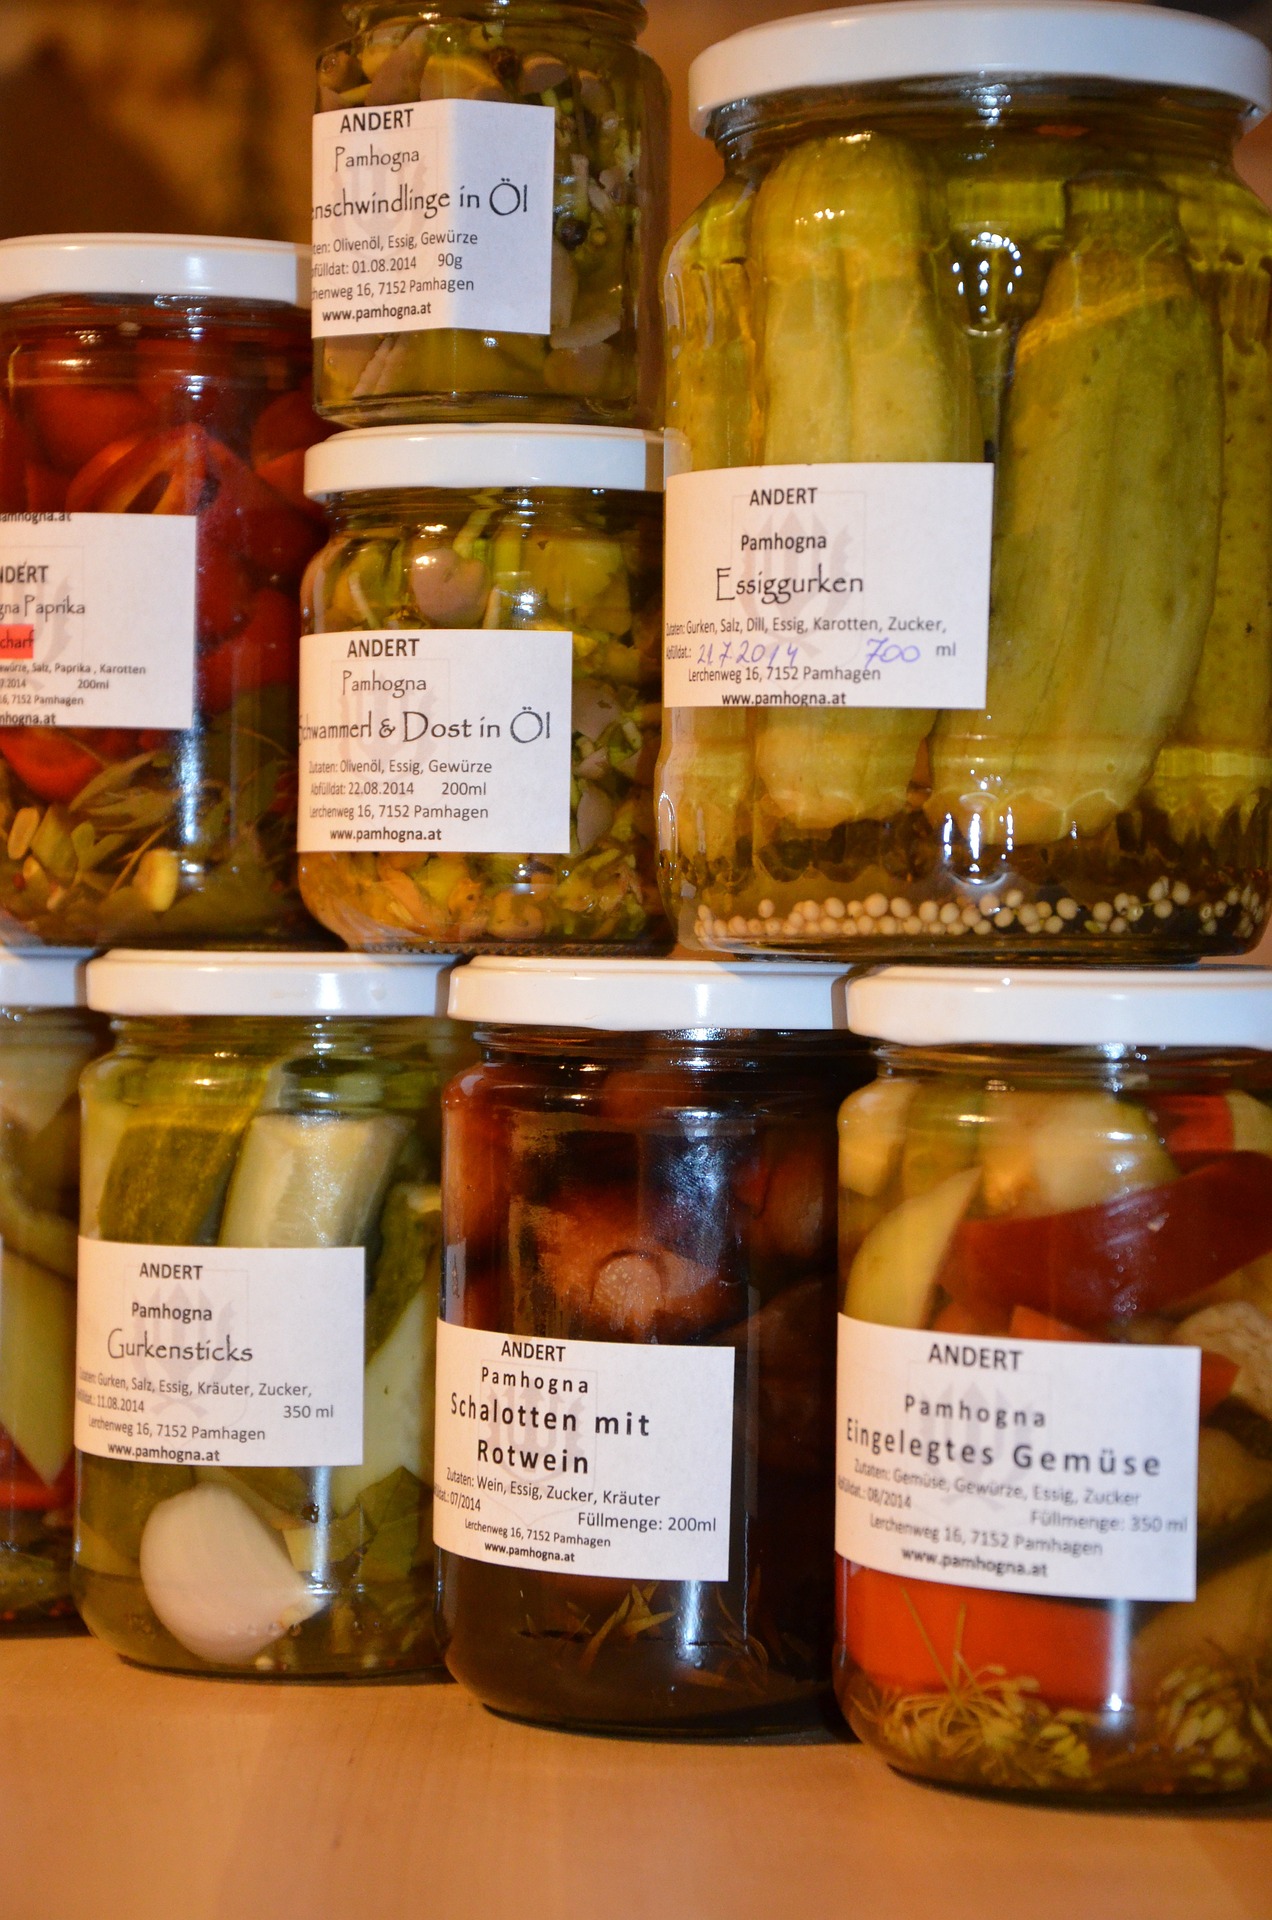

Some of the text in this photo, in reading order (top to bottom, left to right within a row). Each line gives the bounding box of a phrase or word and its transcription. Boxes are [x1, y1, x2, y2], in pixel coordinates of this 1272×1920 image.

[340, 109, 414, 133] ANDERT
[335, 144, 420, 172] Pamhogna
[460, 185, 480, 208] in
[489, 178, 527, 216] Öl
[333, 236, 383, 252] Olivenöl,
[388, 233, 417, 249] Essig,
[421, 230, 478, 246] Gewürze
[352, 256, 416, 274] 01.08.2014
[438, 253, 462, 269] 90g
[312, 277, 474, 301] henweg 16, 7152 Pamhagen
[323, 302, 431, 322] www.pamhogna.at
[750, 487, 818, 506] ANDERT
[741, 533, 827, 553] Pamhogna
[716, 563, 864, 603] Essiggurken
[24, 595, 86, 622] Paprika
[687, 618, 717, 634] Gurken,
[720, 618, 742, 633] Salz,
[746, 617, 768, 632] Dill,
[773, 617, 808, 634] Essig,
[813, 616, 882, 632] Karotten,
[888, 615, 947, 634] Zucker,
[347, 638, 420, 658] ANDERT
[865, 637, 921, 669] 700
[935, 642, 956, 656] ml
[32, 663, 51, 674] Salz,
[55, 663, 91, 675] Paprika
[100, 664, 146, 674] Karotten
[688, 665, 881, 683] Lerchenweg 16, 7152 Pamhagen
[78, 679, 109, 689] 200ml
[342, 670, 427, 698] Pamhogna
[12, 695, 31, 705] 7152
[34, 695, 83, 707] Pamhagen
[722, 691, 846, 706] www.pamhogna.at
[379, 718, 395, 738] &
[403, 711, 472, 742] Dost
[479, 717, 500, 738] in
[510, 706, 550, 743] Öl
[340, 759, 384, 774] Olivenöl,
[389, 760, 424, 775] Essig,
[429, 759, 492, 774] Gewürze
[348, 782, 414, 795] 22.08.2014
[442, 782, 486, 796] 200ml
[309, 804, 489, 821] Lerchenweg 16, 7152 Pamhagen
[330, 827, 442, 842] www.pamhogna.at
[140, 1262, 203, 1280] ANDERT
[132, 1302, 212, 1324] Pamhogna
[108, 1328, 253, 1362] Gurkensticks
[501, 1340, 566, 1362] ANDERT
[929, 1343, 1023, 1371] ANDERT
[98, 1372, 129, 1390] Gurken,
[132, 1377, 155, 1392] Salz,
[159, 1381, 193, 1396] Essig,
[198, 1381, 254, 1397] Kräuter,
[258, 1383, 312, 1398] Zucker,
[482, 1366, 589, 1394] Pamhogna
[97, 1394, 144, 1413] 11.08.2014
[283, 1405, 311, 1418] 350
[316, 1405, 334, 1418] ml
[451, 1392, 650, 1436] Schalotten mit
[904, 1394, 1046, 1428] Pamhogna
[88, 1414, 266, 1441] Lerchenweg 16, 7152 Pamhagen
[108, 1442, 220, 1462] www.pamhogna.at
[478, 1439, 588, 1474] Rotwein
[846, 1417, 1161, 1476] Eingelegtes Gemüse
[446, 1466, 660, 1506] Zutaten: Wein, Essig, Zucker, Kräuter
[893, 1467, 950, 1493] Gemüse,
[954, 1477, 1027, 1501] Gewürze,
[1033, 1484, 1079, 1505] Essig,
[1083, 1488, 1140, 1506] Zucker
[450, 1490, 480, 1512] 07/2014
[578, 1512, 662, 1532] Füllmenge:
[668, 1517, 716, 1532] 200ml
[1031, 1509, 1125, 1532] Füllmenge:
[1130, 1515, 1161, 1533] 350
[1166, 1516, 1187, 1533] ml
[465, 1518, 611, 1548] Lerchenweg 16, 7152 Pamhagen
[870, 1512, 1103, 1556] Lerchenweg 16, 7152 Pamhagen
[484, 1540, 575, 1562] www.pamhogna.at
[901, 1546, 1047, 1577] www.pamhogna.at
